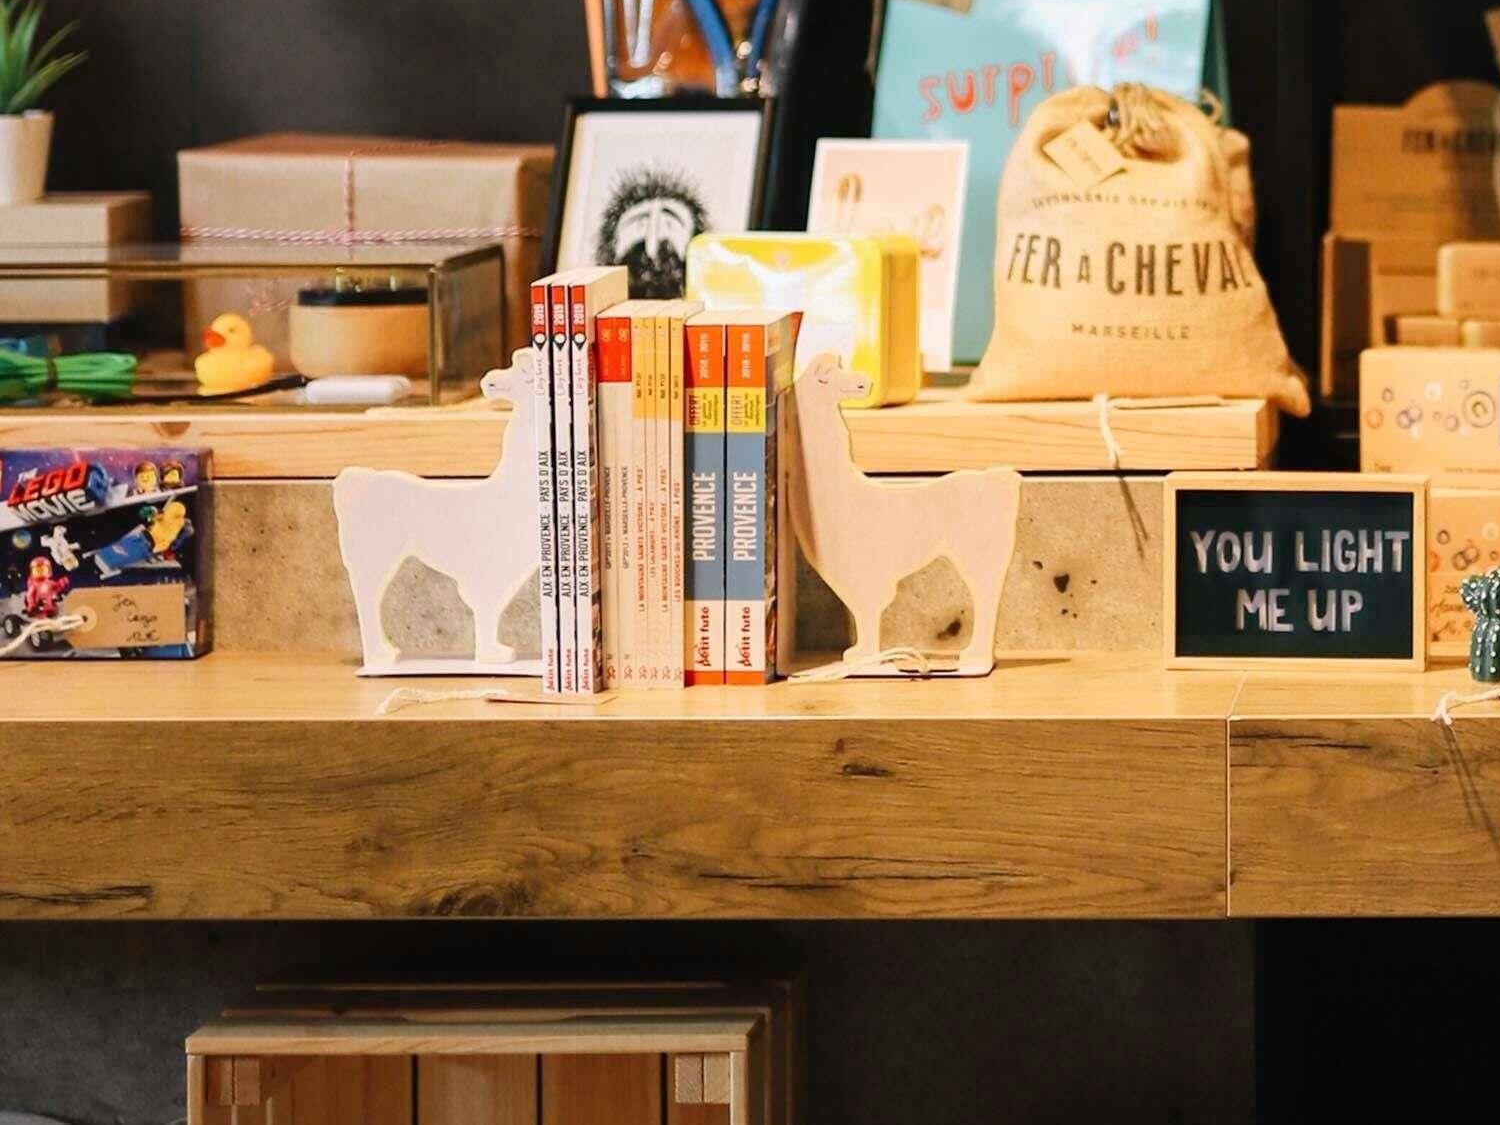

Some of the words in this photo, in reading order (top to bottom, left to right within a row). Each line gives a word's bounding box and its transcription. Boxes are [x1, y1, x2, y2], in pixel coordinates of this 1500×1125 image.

[1007, 232, 1063, 289] FER
[1105, 240, 1254, 297] CHEVAL
[1072, 323, 1191, 340] MARSEILLE
[688, 394, 701, 426] OFFERT
[731, 394, 743, 426] OFFERT
[8, 460, 90, 507] LEGO
[538, 479, 550, 502] PAYS
[558, 479, 569, 502] PAYS
[577, 479, 588, 502] PAYS
[16, 488, 96, 523] MOVIE
[692, 472, 716, 562] PROVENCE
[733, 472, 757, 562] PROVENCE
[1189, 529, 1274, 574] YOU
[1295, 529, 1410, 574] LIGHT
[1235, 588, 1295, 632] ME
[1307, 588, 1364, 633] UP
